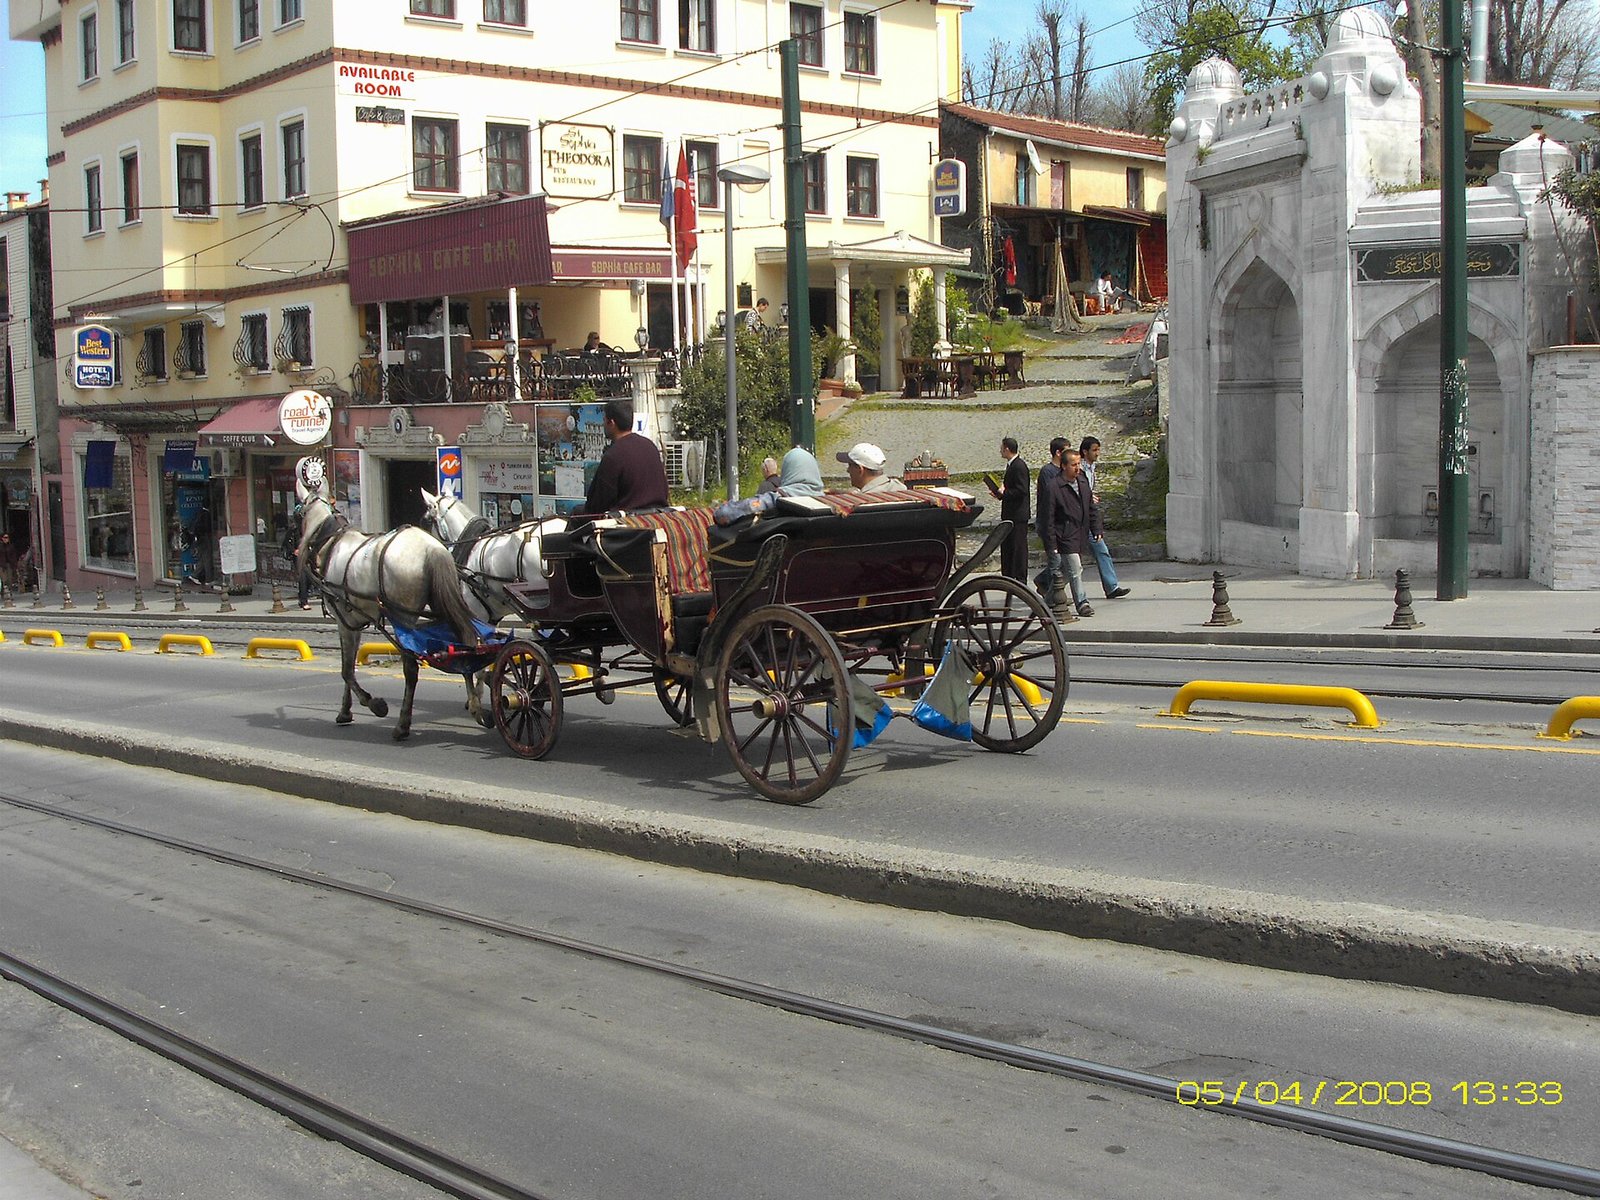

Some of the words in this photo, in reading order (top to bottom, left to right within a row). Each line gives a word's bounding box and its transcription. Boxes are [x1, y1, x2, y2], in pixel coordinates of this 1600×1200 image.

[340, 65, 415, 82] AVAILABLE
[354, 82, 401, 96] ROOM
[543, 149, 611, 168] THEODORA
[432, 245, 472, 271] CAFE
[483, 238, 519, 265] BAR
[552, 261, 563, 274] AR
[623, 261, 643, 274] CAFE
[645, 261, 662, 275] BAR
[86, 338, 103, 348] Best
[80, 345, 109, 355] Western
[284, 406, 309, 417] road
[291, 417, 325, 428] runner
